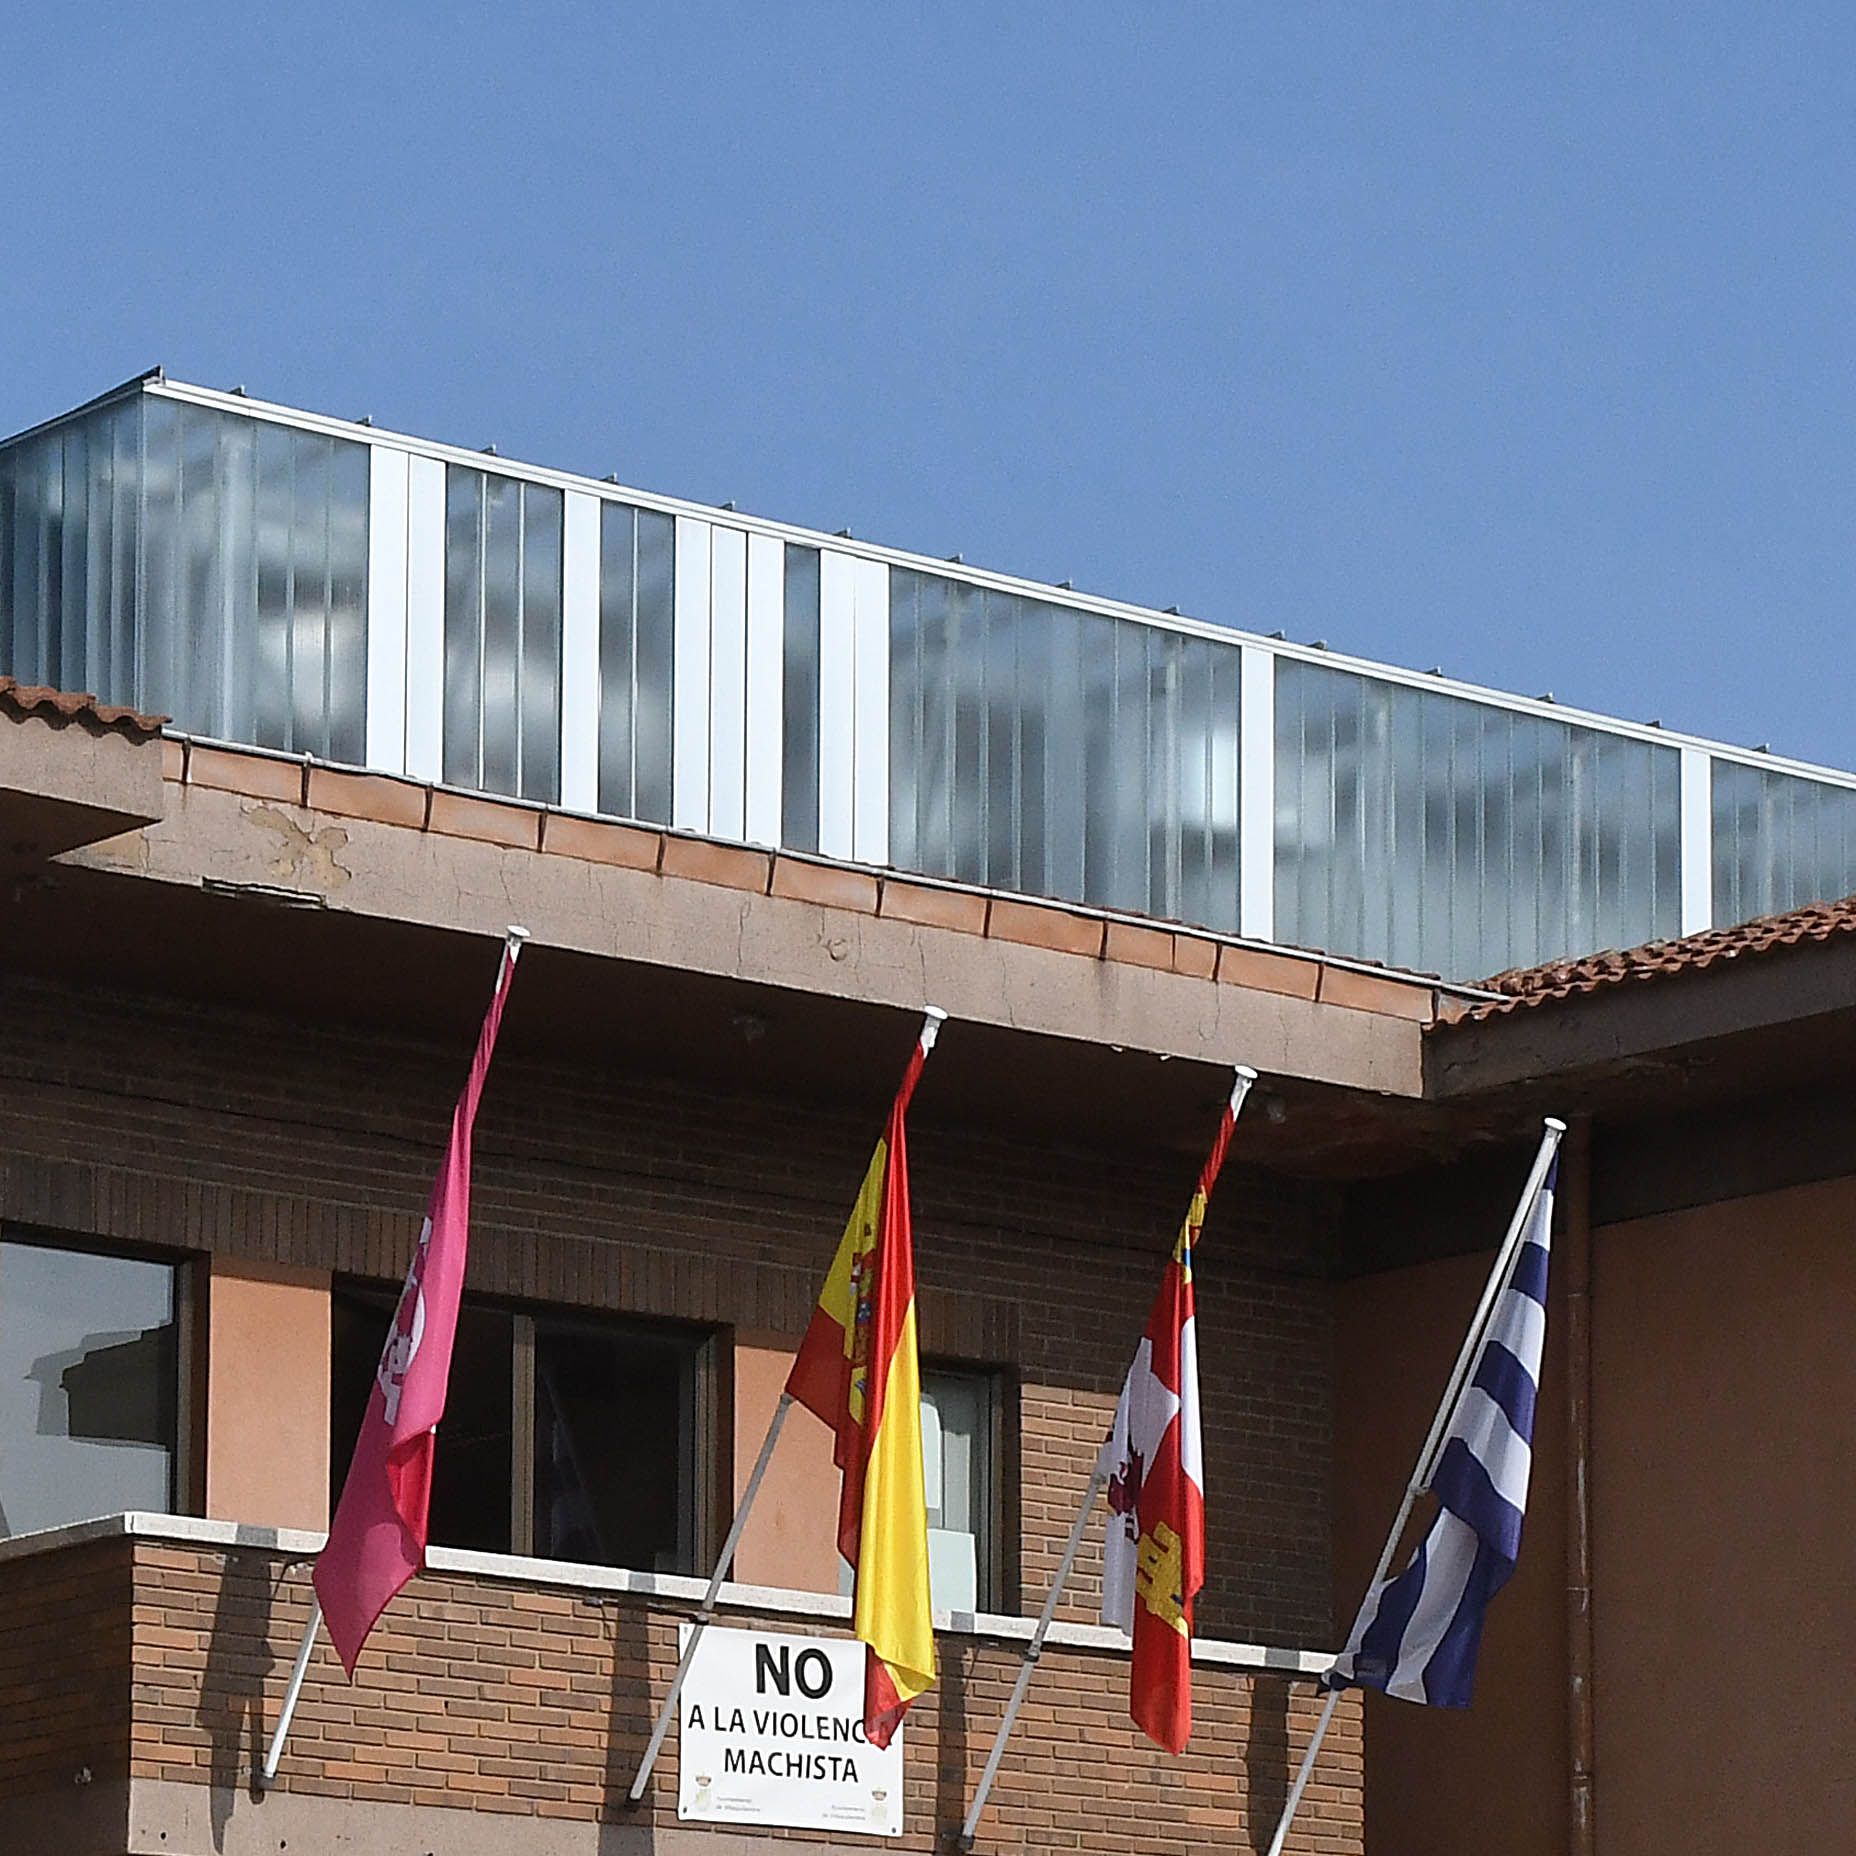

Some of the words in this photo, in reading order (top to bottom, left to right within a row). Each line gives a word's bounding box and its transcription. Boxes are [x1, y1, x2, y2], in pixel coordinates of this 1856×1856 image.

[754, 1642, 833, 1700] NO
[688, 1704, 705, 1730] A
[714, 1706, 746, 1734] LA
[753, 1709, 892, 1746] VIOLENC
[723, 1747, 859, 1783] MACHISTA
